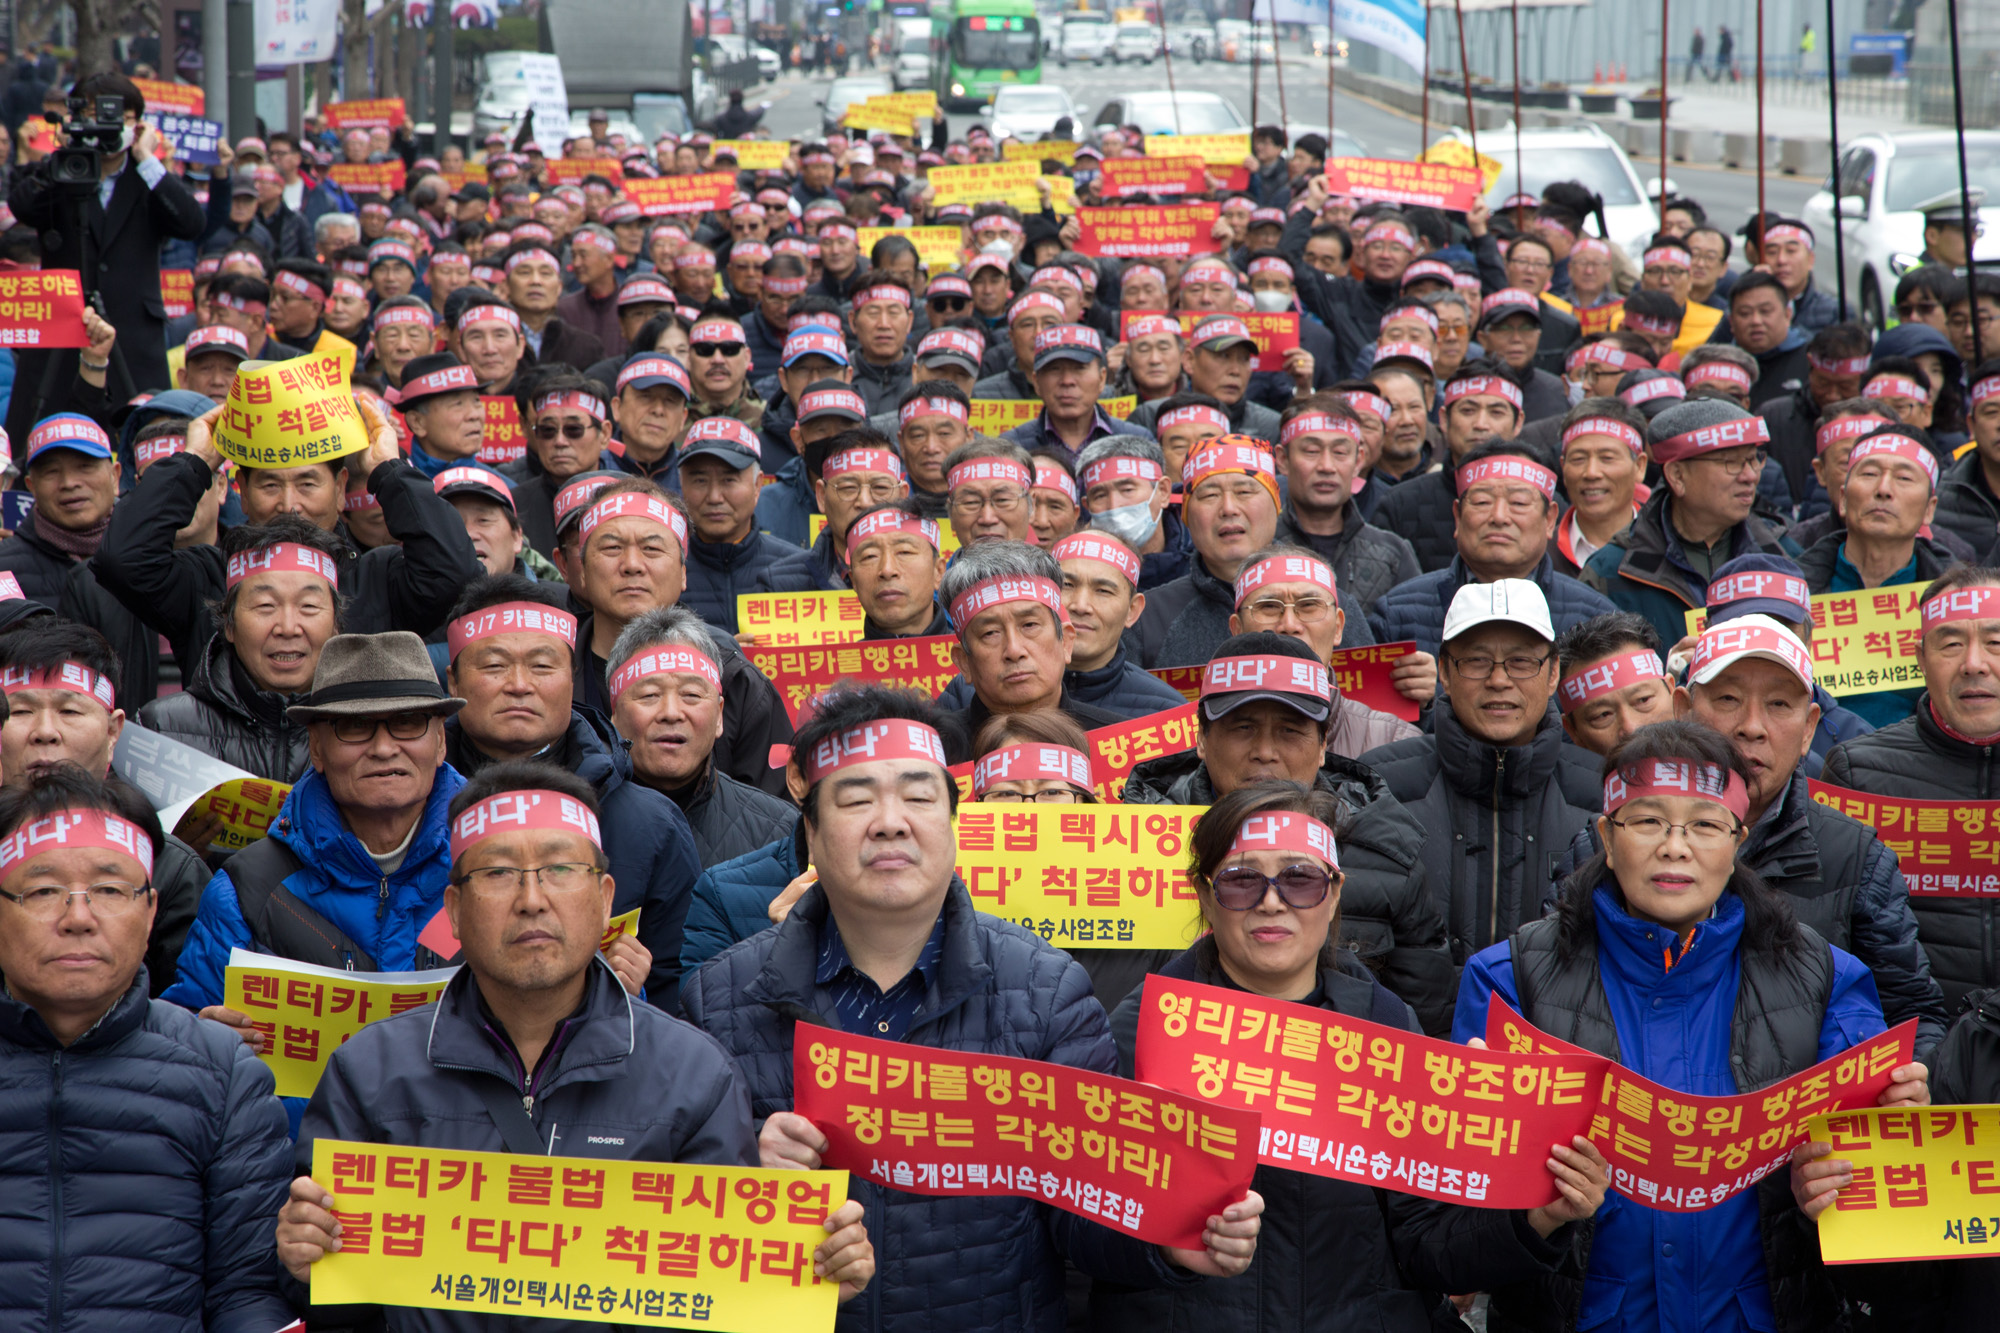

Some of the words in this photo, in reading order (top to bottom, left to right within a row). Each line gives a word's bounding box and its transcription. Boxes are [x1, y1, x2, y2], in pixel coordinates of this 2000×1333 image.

[1688, 420, 1750, 449] '타다'
[1466, 463, 1486, 483] 3/7
[1069, 539, 1130, 574] 카풀합의
[1285, 558, 1333, 589] 퇴출
[966, 579, 1039, 611] 카풀합의
[1711, 574, 1774, 601] '타다'
[1923, 589, 1991, 620] '타다'
[464, 612, 496, 638] 3/7
[502, 608, 572, 641] 카풀합의
[747, 600, 827, 625] 렌터카
[838, 595, 864, 621] 불
[627, 652, 695, 680] 카풀합의
[753, 643, 919, 682] 영리카풀행위
[1207, 660, 1277, 689] '타다'
[1562, 661, 1620, 701] '타다'
[61, 662, 112, 706] 퇴출
[1039, 748, 1089, 786] 퇴출
[454, 794, 542, 840] '타다'
[957, 812, 1039, 853] 불법
[242, 974, 374, 1025] 렌터카
[1158, 992, 1406, 1083] 영리카풀행위
[1424, 1050, 1587, 1106] 방조하는
[808, 1042, 1057, 1112] 영리카풀행위
[1077, 1080, 1238, 1161] 방조하는
[1762, 1039, 1901, 1123] 방조하는
[1191, 1052, 1317, 1117] 정부는
[1337, 1082, 1521, 1157] 각성하라!
[847, 1103, 975, 1148] 정부는
[996, 1114, 1173, 1191] 각성하라!
[1826, 1111, 1980, 1152] 렌터카
[1258, 1126, 1491, 1201] 인택시운송사업조합
[332, 1152, 488, 1203] 렌터카
[507, 1164, 606, 1210] 불법
[632, 1171, 831, 1227] 택시영업
[870, 1159, 1144, 1231] 서울개인택시운송사업조합
[329, 1209, 426, 1259] 불법
[451, 1214, 583, 1269] '타다'
[431, 1273, 714, 1322] 서울개인택시운송사업조합
